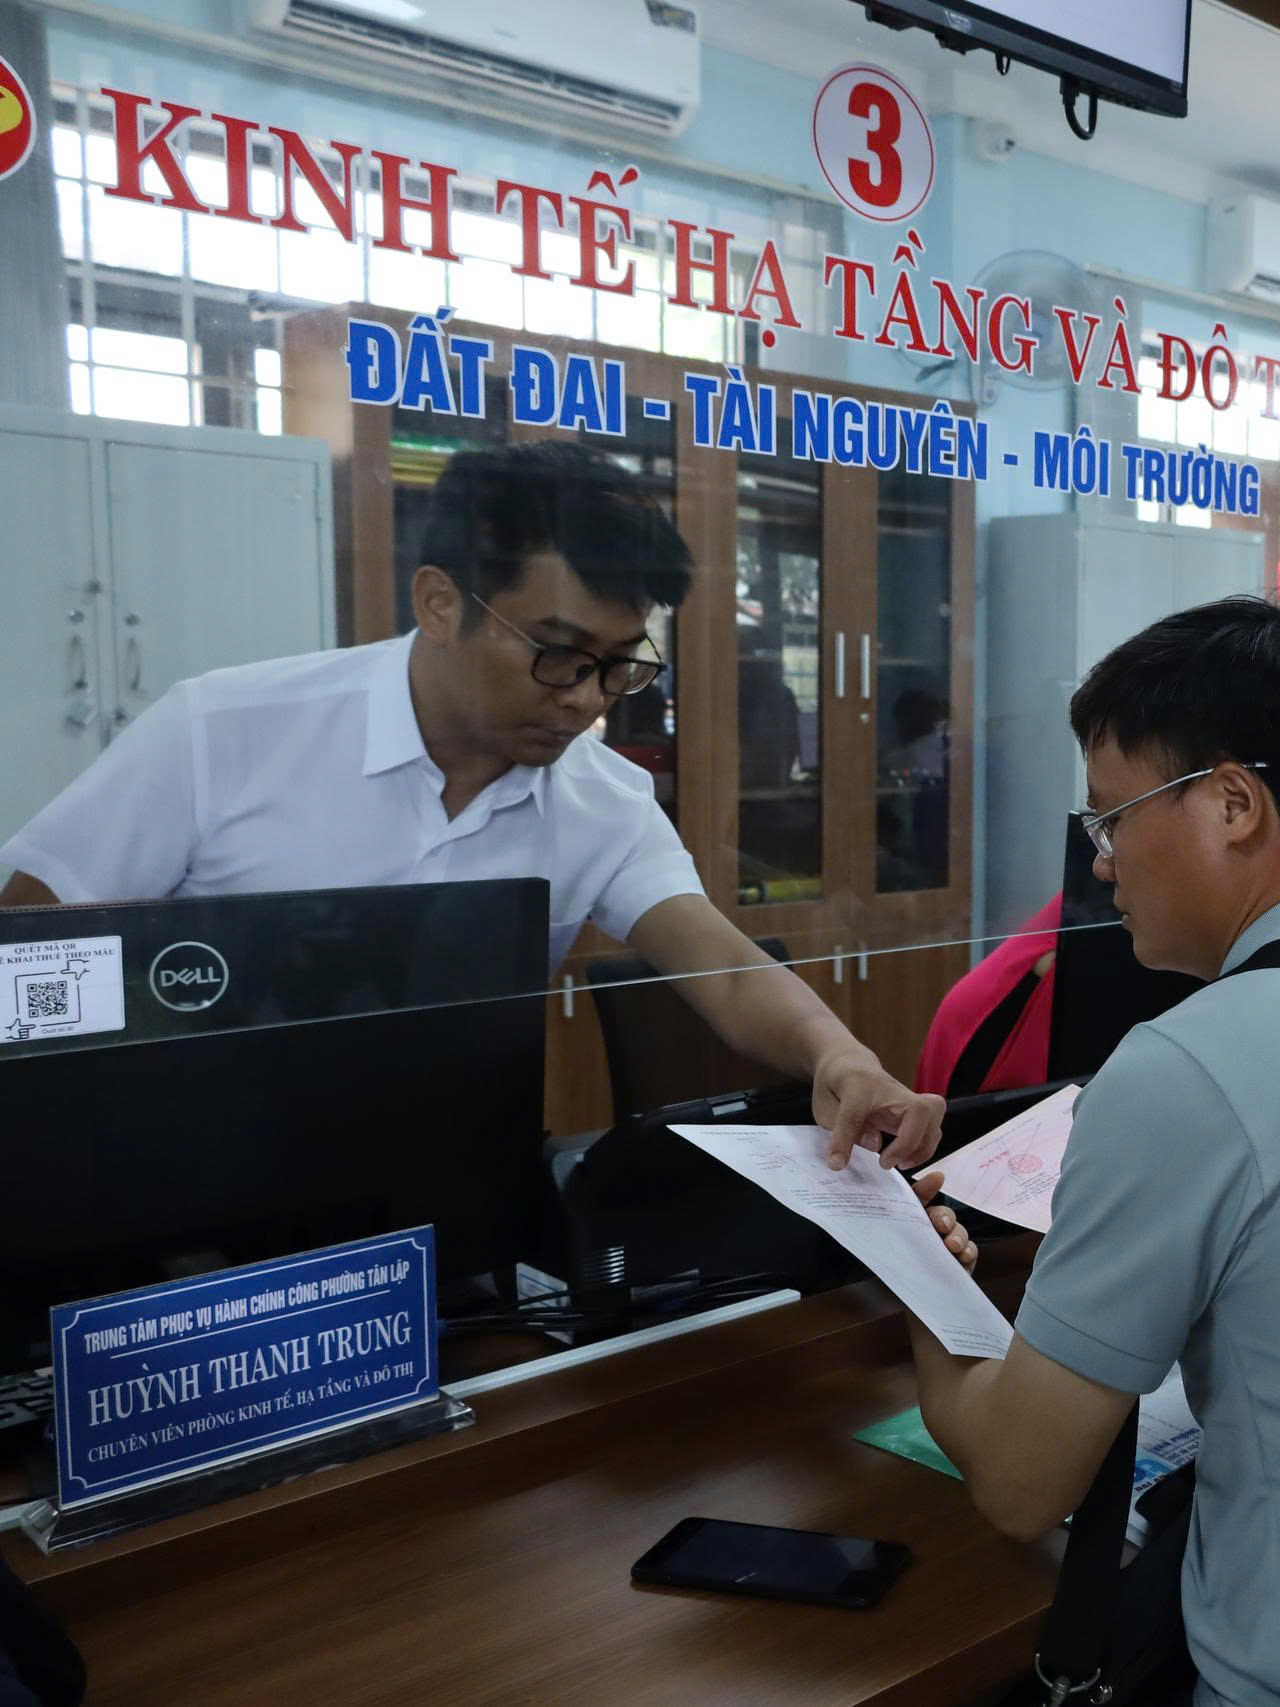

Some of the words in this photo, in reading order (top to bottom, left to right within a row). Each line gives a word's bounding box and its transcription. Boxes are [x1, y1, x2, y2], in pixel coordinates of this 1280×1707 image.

[847, 82, 902, 208] 3
[102, 88, 459, 263] KINH
[496, 167, 640, 296] TẾ
[668, 219, 802, 349] HẠ
[823, 230, 1039, 376] TẦNG
[1054, 297, 1142, 396] VÀ
[1156, 324, 1239, 413] ĐÔ
[346, 306, 494, 421] ĐẤT
[509, 343, 626, 437] ĐAI
[685, 368, 776, 458] TÀI
[792, 391, 989, 482] NGUYÊN
[1033, 426, 1112, 498] MÔI
[1122, 444, 1260, 518] TRƯỜNG
[7, 956, 33, 965] KHAI
[64, 949, 91, 960] THEO
[62, 943, 77, 951] QR
[160, 966, 222, 988] DELL
[84, 1325, 128, 1354] TRUNG
[129, 1318, 158, 1344] TÂM
[160, 1311, 194, 1337] PHỤC
[196, 1306, 212, 1331] VỤ
[215, 1298, 248, 1324] HÀNH
[250, 1289, 286, 1316] CHÍNH
[288, 1281, 319, 1307] CÔNG
[321, 1270, 365, 1299] PHƯỜNG
[367, 1264, 389, 1287] TÂN
[390, 1259, 410, 1285] LẬP
[88, 1363, 202, 1427] HUỲNH
[208, 1336, 312, 1394] THANH
[318, 1310, 412, 1366] TRUNG
[88, 1433, 149, 1463] CHUYÊN
[151, 1423, 185, 1446] VIÊN
[188, 1412, 236, 1437] PHÒNG
[238, 1399, 273, 1423] KINH
[296, 1390, 315, 1407] HẠ
[354, 1370, 371, 1389] VÀ
[373, 1365, 391, 1384] ĐÔ
[393, 1361, 414, 1378] THỊ
